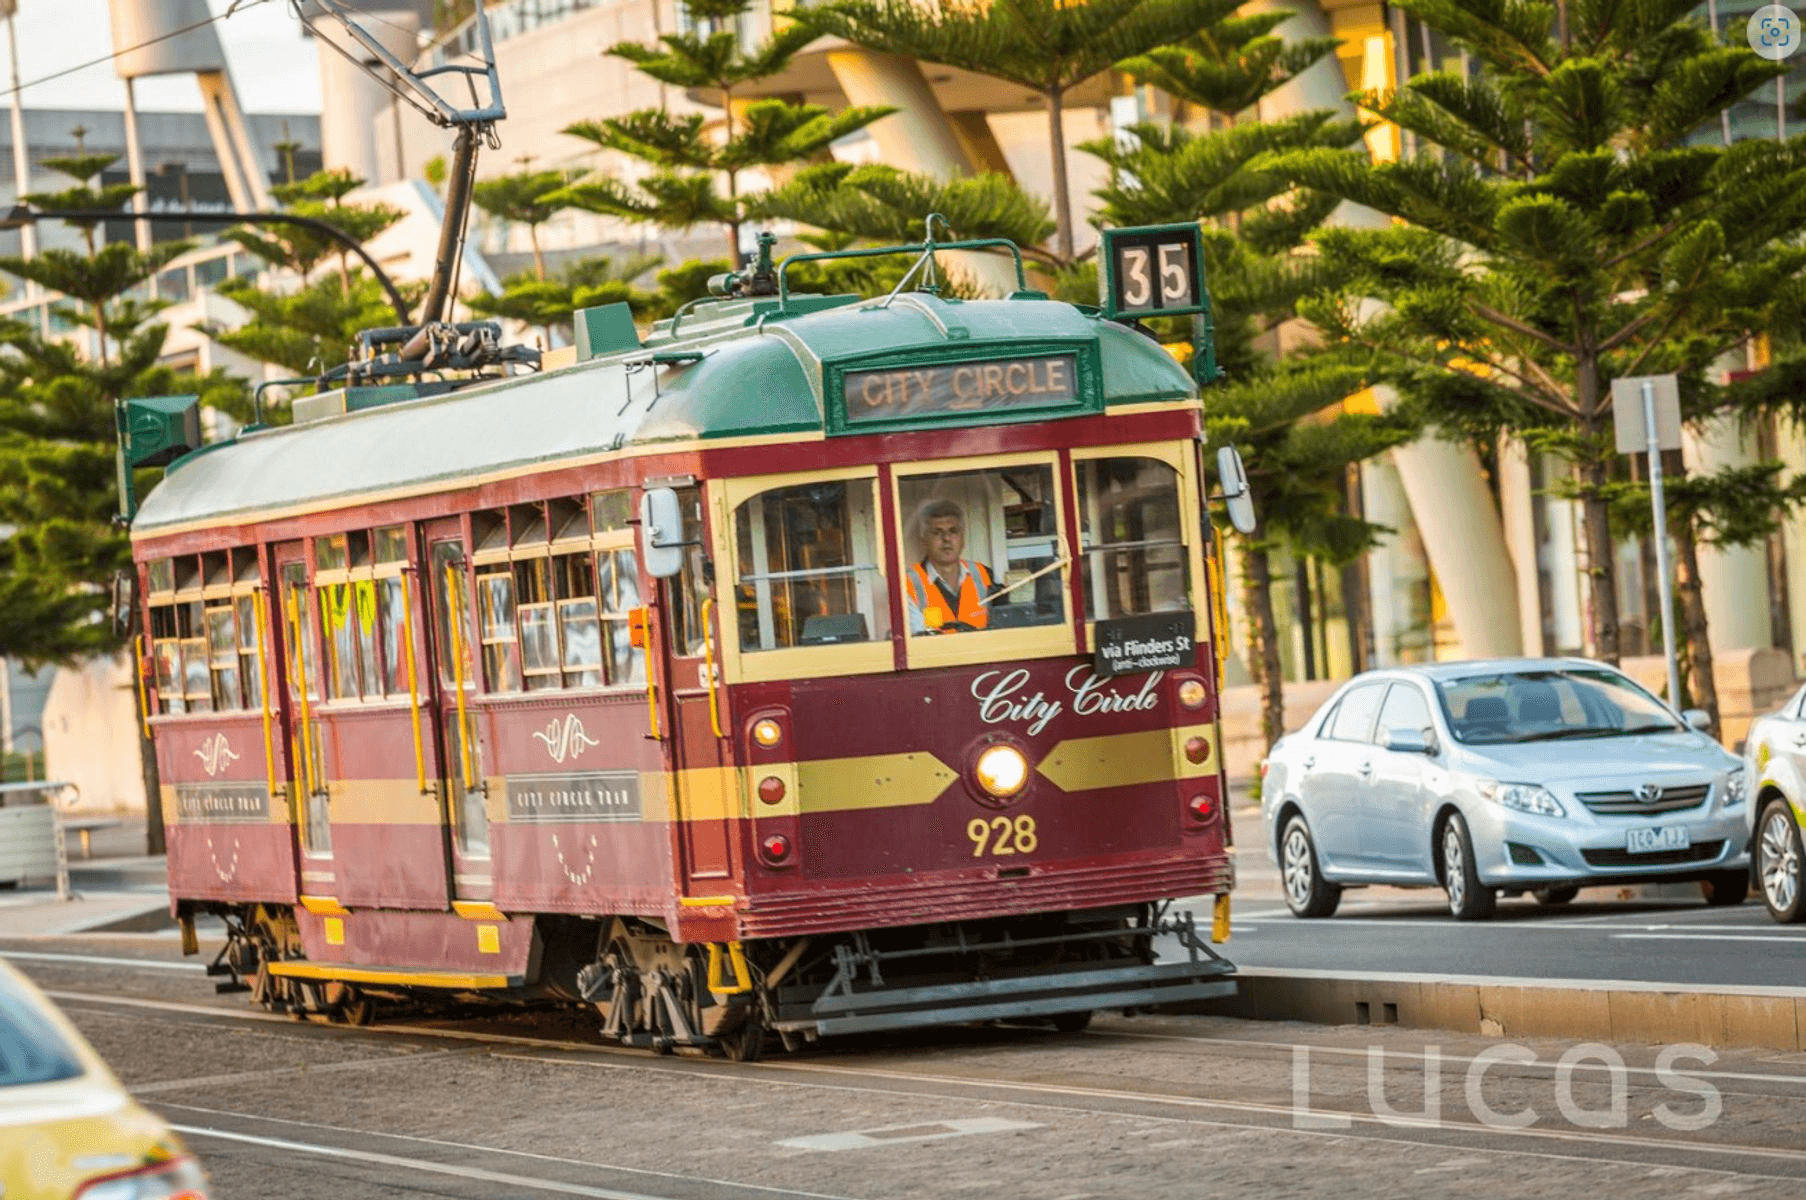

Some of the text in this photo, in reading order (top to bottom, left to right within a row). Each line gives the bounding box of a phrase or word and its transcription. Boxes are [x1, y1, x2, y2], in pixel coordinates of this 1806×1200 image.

[1123, 242, 1188, 305] 35
[862, 360, 1068, 406] CITY CIRCLE
[1101, 635, 1191, 659] via Flinders St
[971, 663, 1164, 736] City Circle
[549, 789, 592, 806] CIRCLE
[967, 814, 1038, 857] 928
